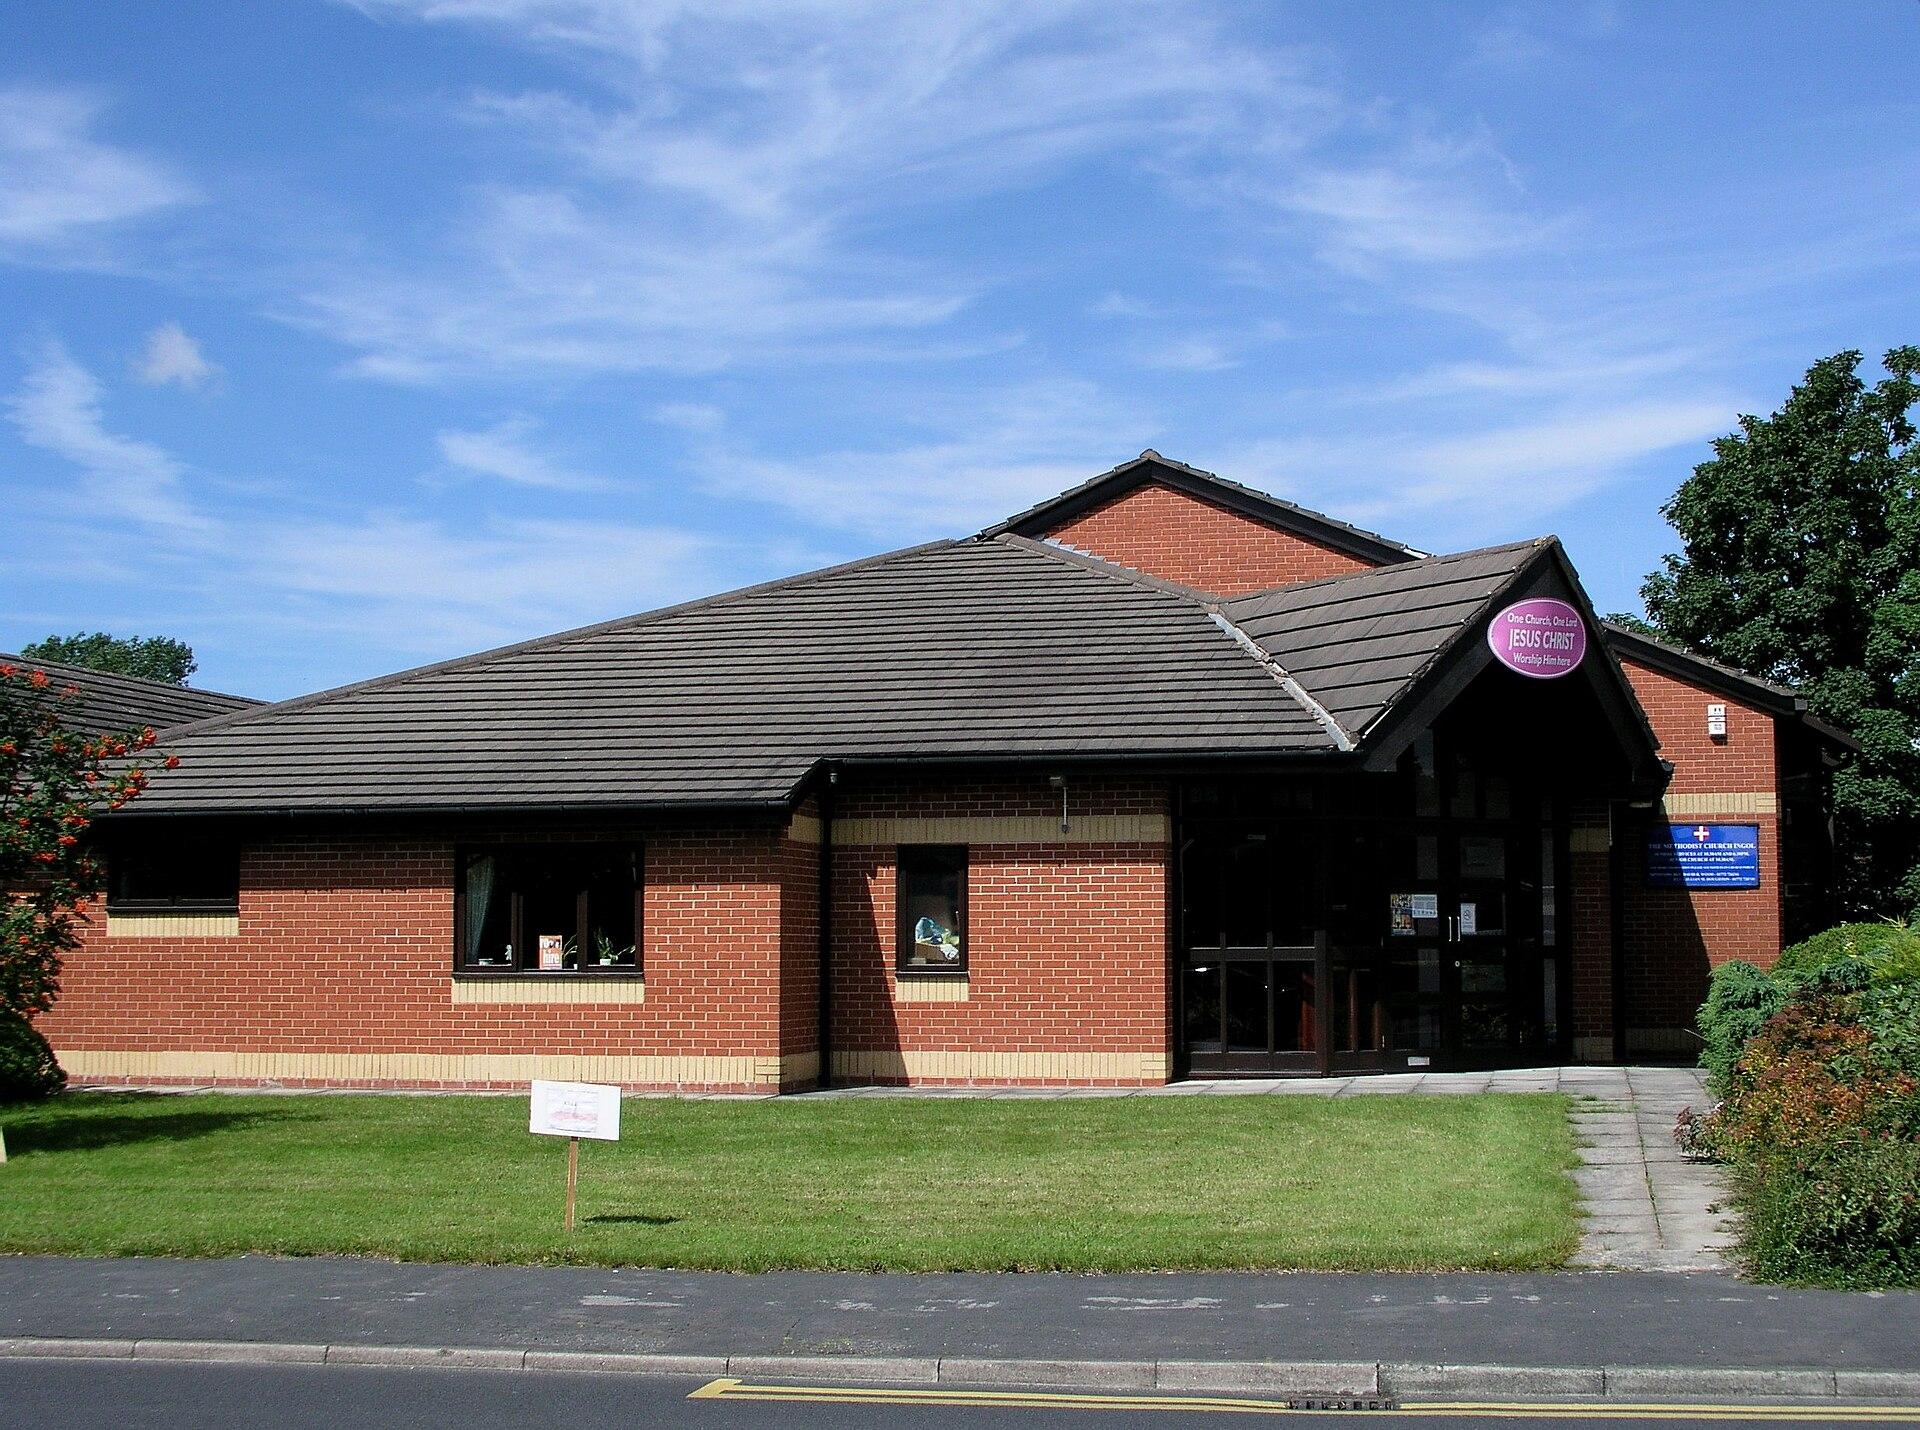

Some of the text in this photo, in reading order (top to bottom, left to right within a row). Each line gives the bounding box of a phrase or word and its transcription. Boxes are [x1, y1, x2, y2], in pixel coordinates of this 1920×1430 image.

[1507, 612, 1577, 627] One Church, One Lord
[1508, 628, 1575, 650] JESUS CHRIST
[1513, 652, 1571, 667] Worship Him here
